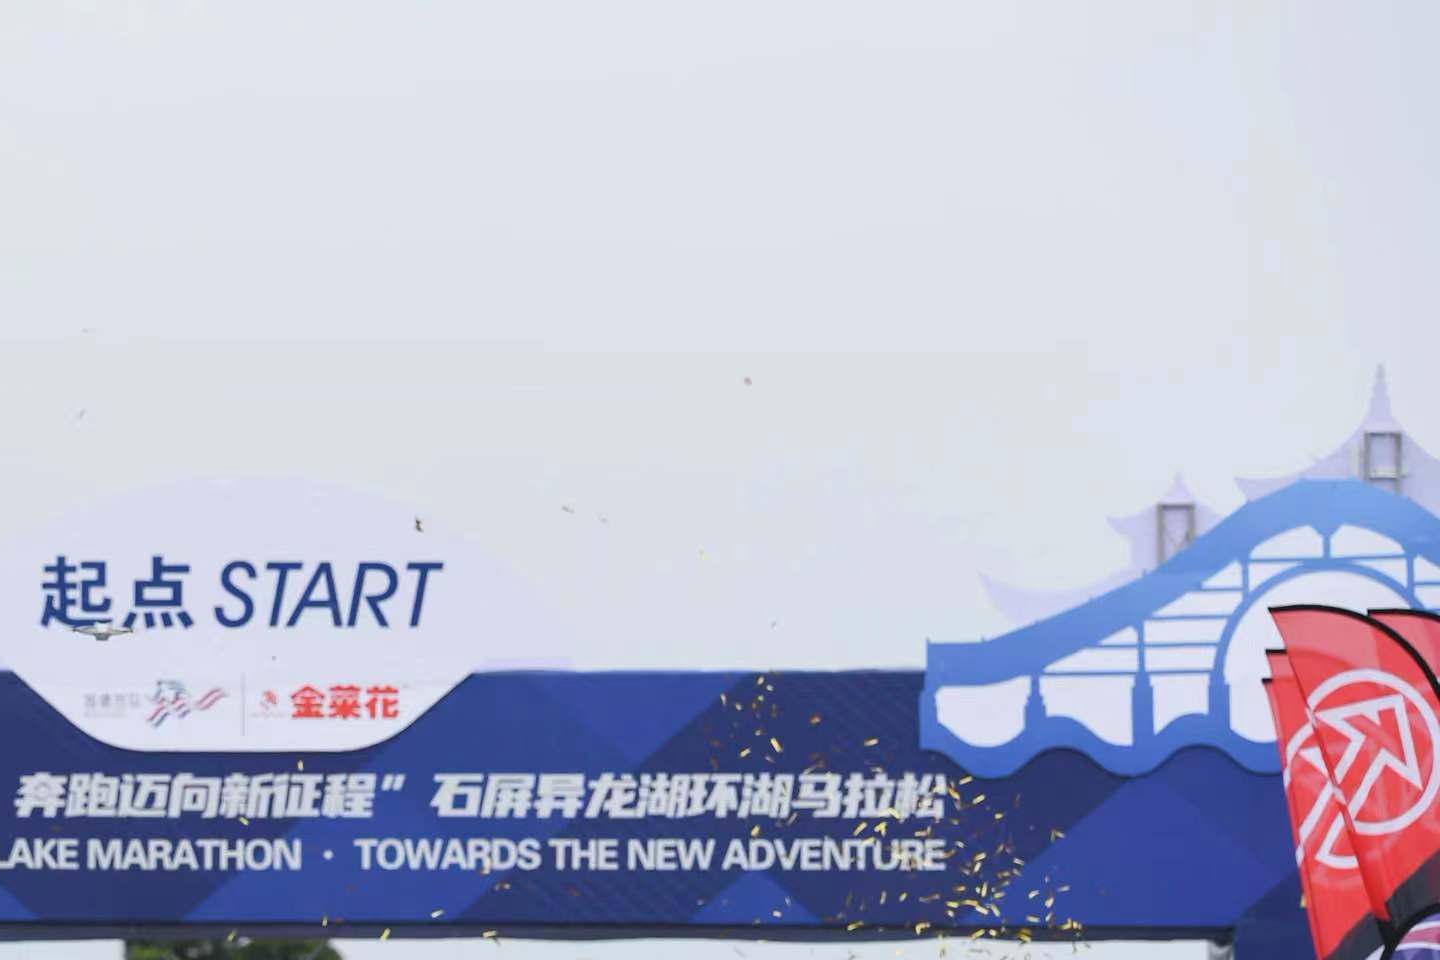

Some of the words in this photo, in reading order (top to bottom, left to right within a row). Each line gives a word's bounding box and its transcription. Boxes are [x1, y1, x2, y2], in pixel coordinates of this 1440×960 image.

[40, 556, 194, 629] 起点
[214, 561, 444, 628] START
[290, 684, 400, 720] 金菜花
[86, 838, 302, 871] MARATHON
[353, 838, 542, 871] TOWARDS
[548, 838, 619, 871] THE
[627, 838, 717, 871] NEW
[722, 838, 947, 872] ADVENTURE
